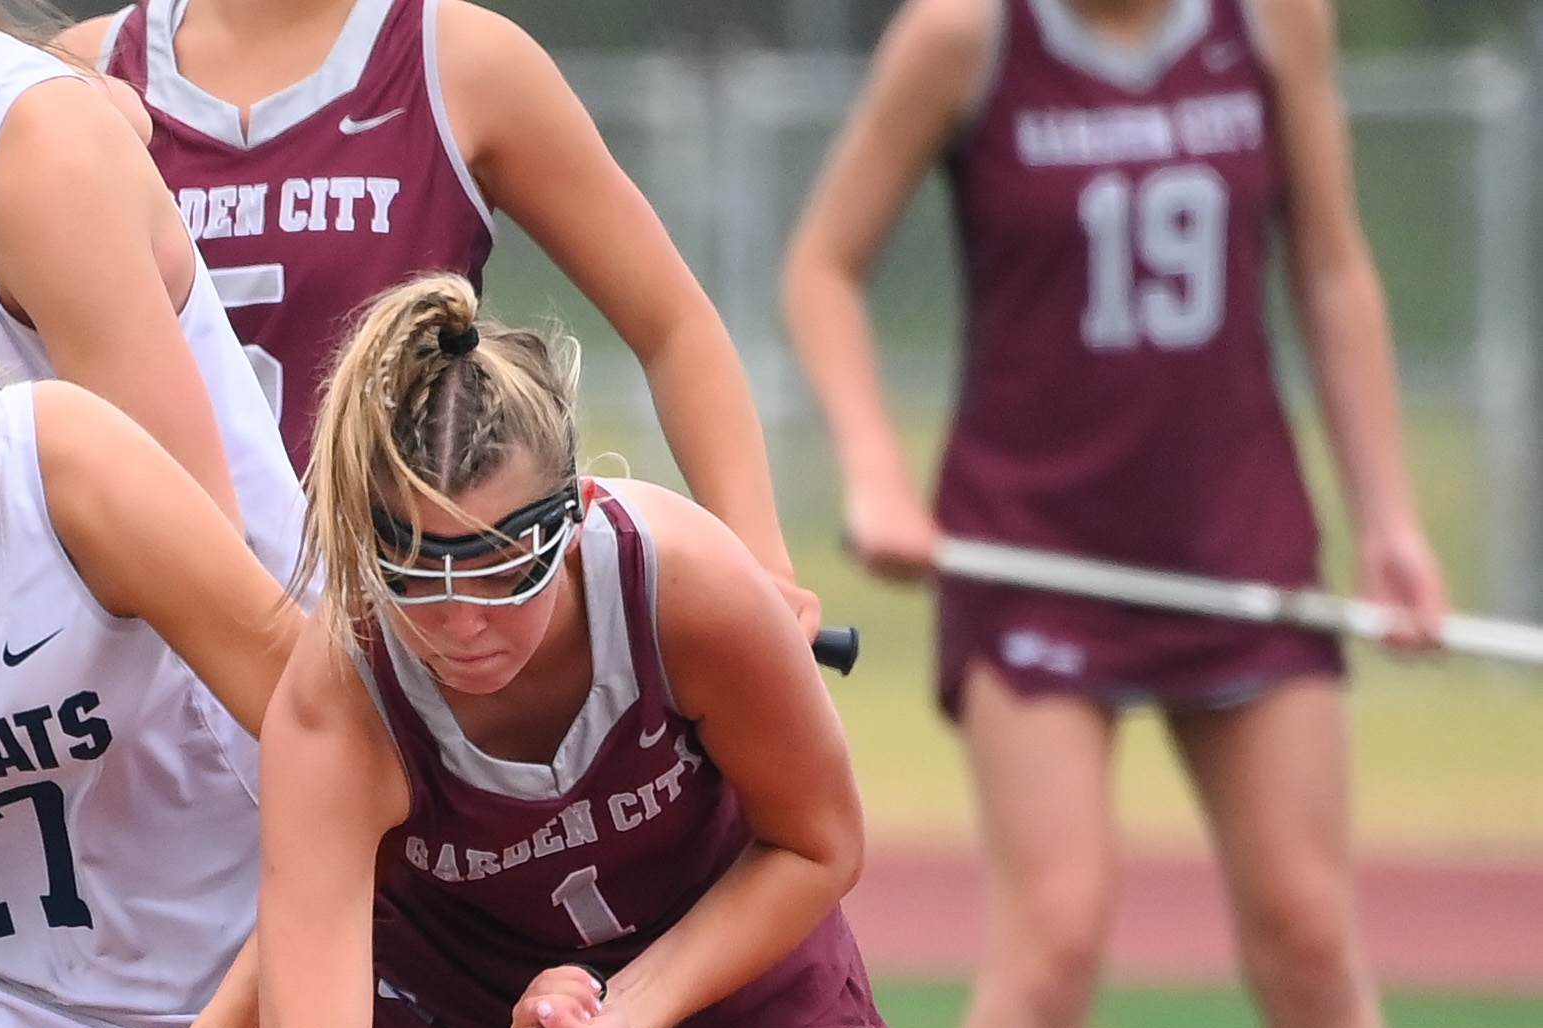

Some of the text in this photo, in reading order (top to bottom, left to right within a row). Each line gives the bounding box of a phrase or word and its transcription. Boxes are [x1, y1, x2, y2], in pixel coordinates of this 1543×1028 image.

[171, 177, 401, 241] DEN CITY
[1076, 164, 1231, 353] 19
[405, 735, 702, 882] GARDEN CITY
[551, 865, 637, 949] 1
